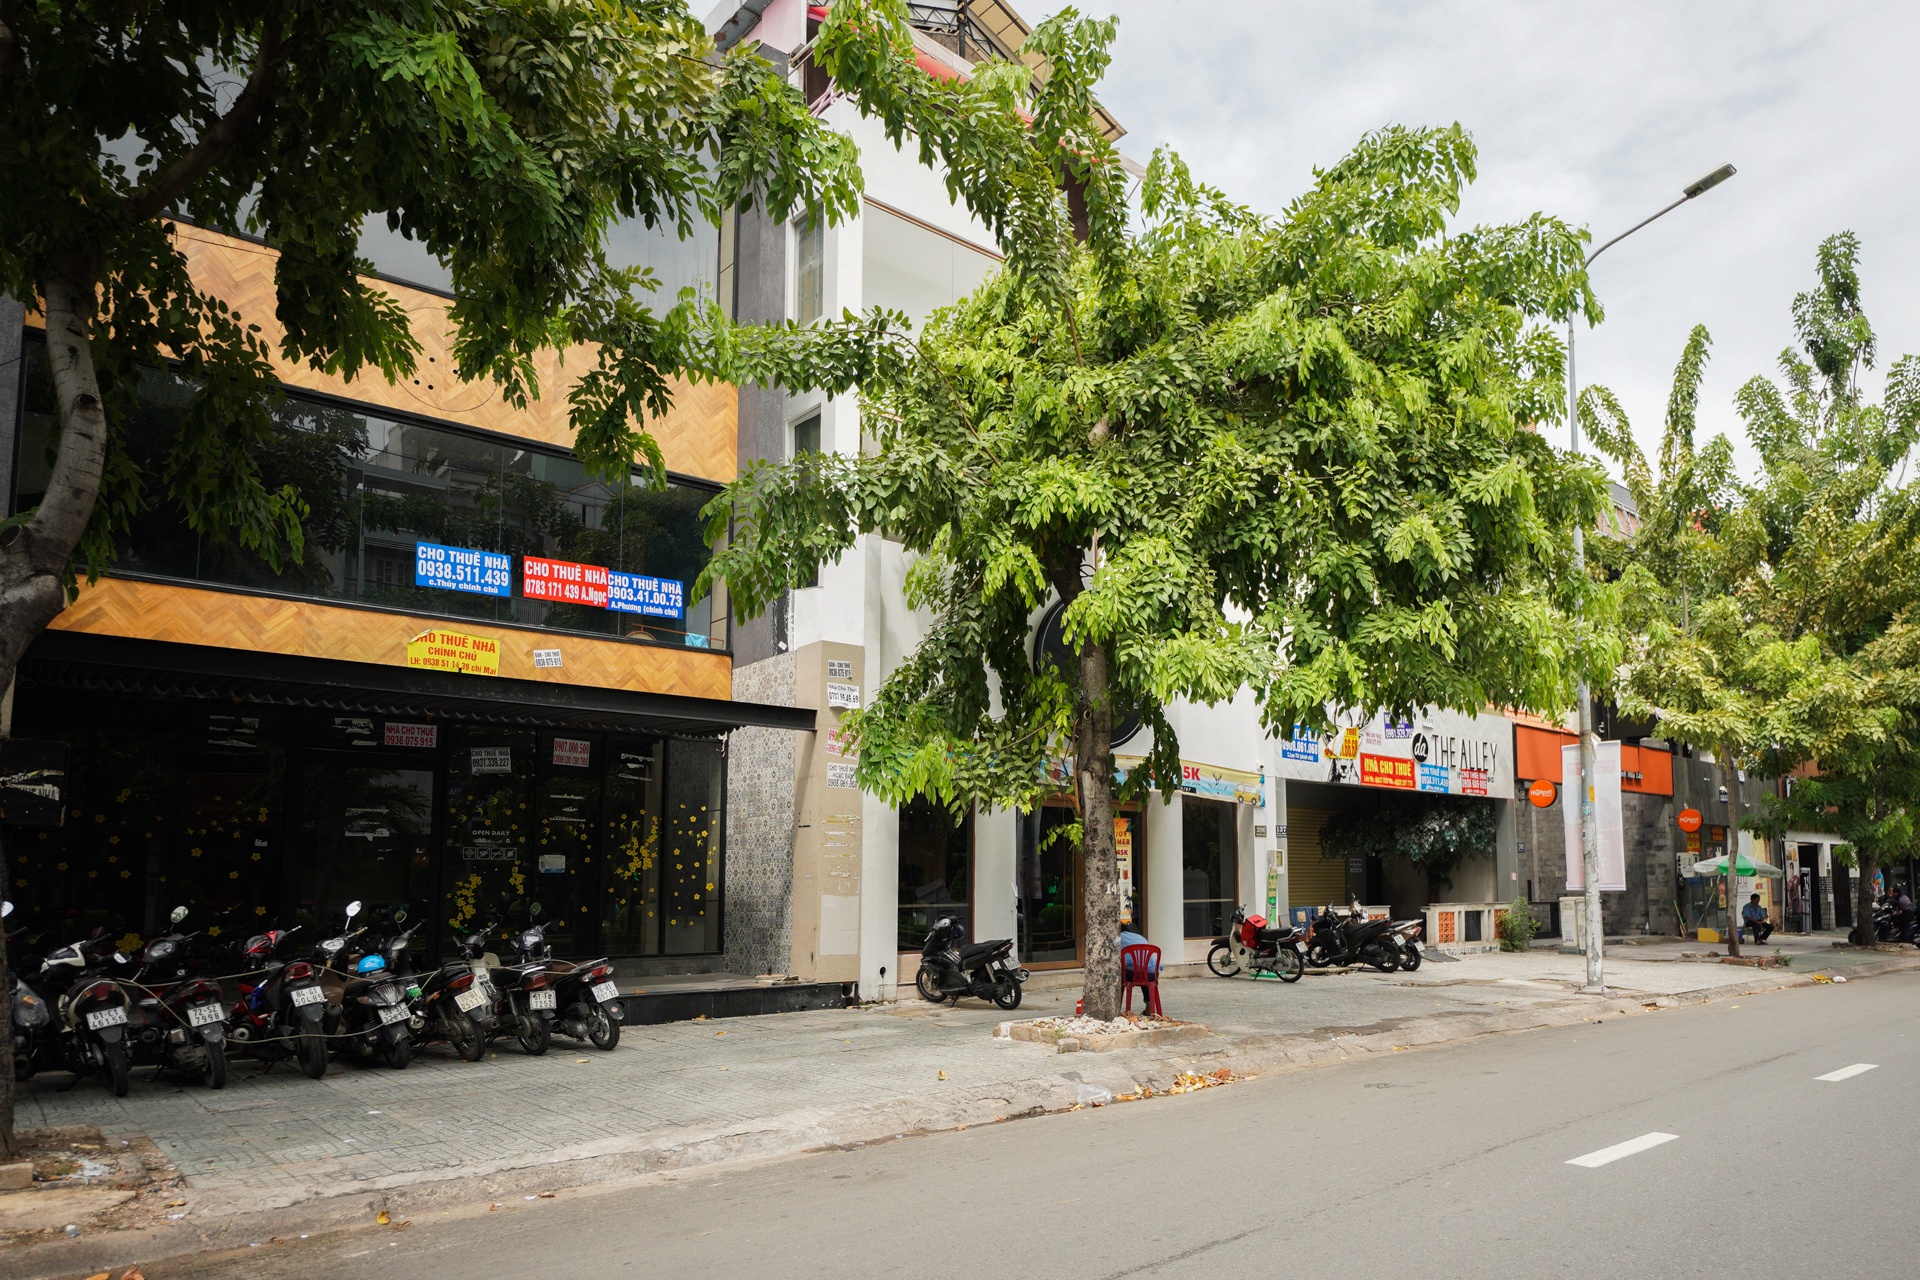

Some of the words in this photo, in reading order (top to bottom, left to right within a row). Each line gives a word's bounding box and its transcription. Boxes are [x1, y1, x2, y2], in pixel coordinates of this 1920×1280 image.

[417, 546, 445, 562] CHO
[448, 551, 481, 567] THUÊ
[484, 555, 509, 571] NHÀ
[417, 559, 509, 589] 0938.511.439
[525, 560, 549, 577] CHO
[552, 565, 582, 582] THUÊ
[584, 568, 607, 585] NHÀ
[458, 582, 481, 594] chính
[483, 585, 499, 596] chủ
[525, 578, 546, 596] 0783
[547, 580, 562, 598] 171
[564, 583, 579, 600] 439
[580, 585, 607, 606] A.Ngọc
[608, 574, 629, 589] CHO
[631, 577, 658, 592] THUÊ
[661, 580, 682, 596] NHÀ
[607, 586, 682, 608] 0903.41.00.73
[643, 605, 663, 616] (chính
[439, 633, 469, 648] THUÊ
[472, 639, 496, 653] NHÀ
[427, 645, 456, 658] CHÍNH
[458, 651, 477, 662] CHỦ
[410, 657, 421, 666] LH:
[422, 657, 440, 667] 0938
[441, 659, 449, 668] 51
[461, 662, 470, 671] 39
[484, 666, 497, 676] Mai
[386, 724, 400, 735] NHÀ
[402, 726, 416, 736] CHO
[417, 726, 435, 738] THUÊ
[385, 734, 404, 745] 0936
[405, 736, 419, 746] 075
[420, 736, 434, 747] 915
[484, 749, 497, 757] THUÊ
[1432, 734, 1456, 768] THE
[1460, 738, 1498, 773] ALLEY
[829, 764, 838, 772] CHO
[1364, 756, 1378, 773] NHÀ
[1379, 760, 1394, 775] CHO
[1395, 759, 1412, 777] THUÊ
[93, 1008, 118, 1020] 61-C1
[193, 1004, 217, 1017] 72-S2
[196, 1013, 220, 1024] 7998
